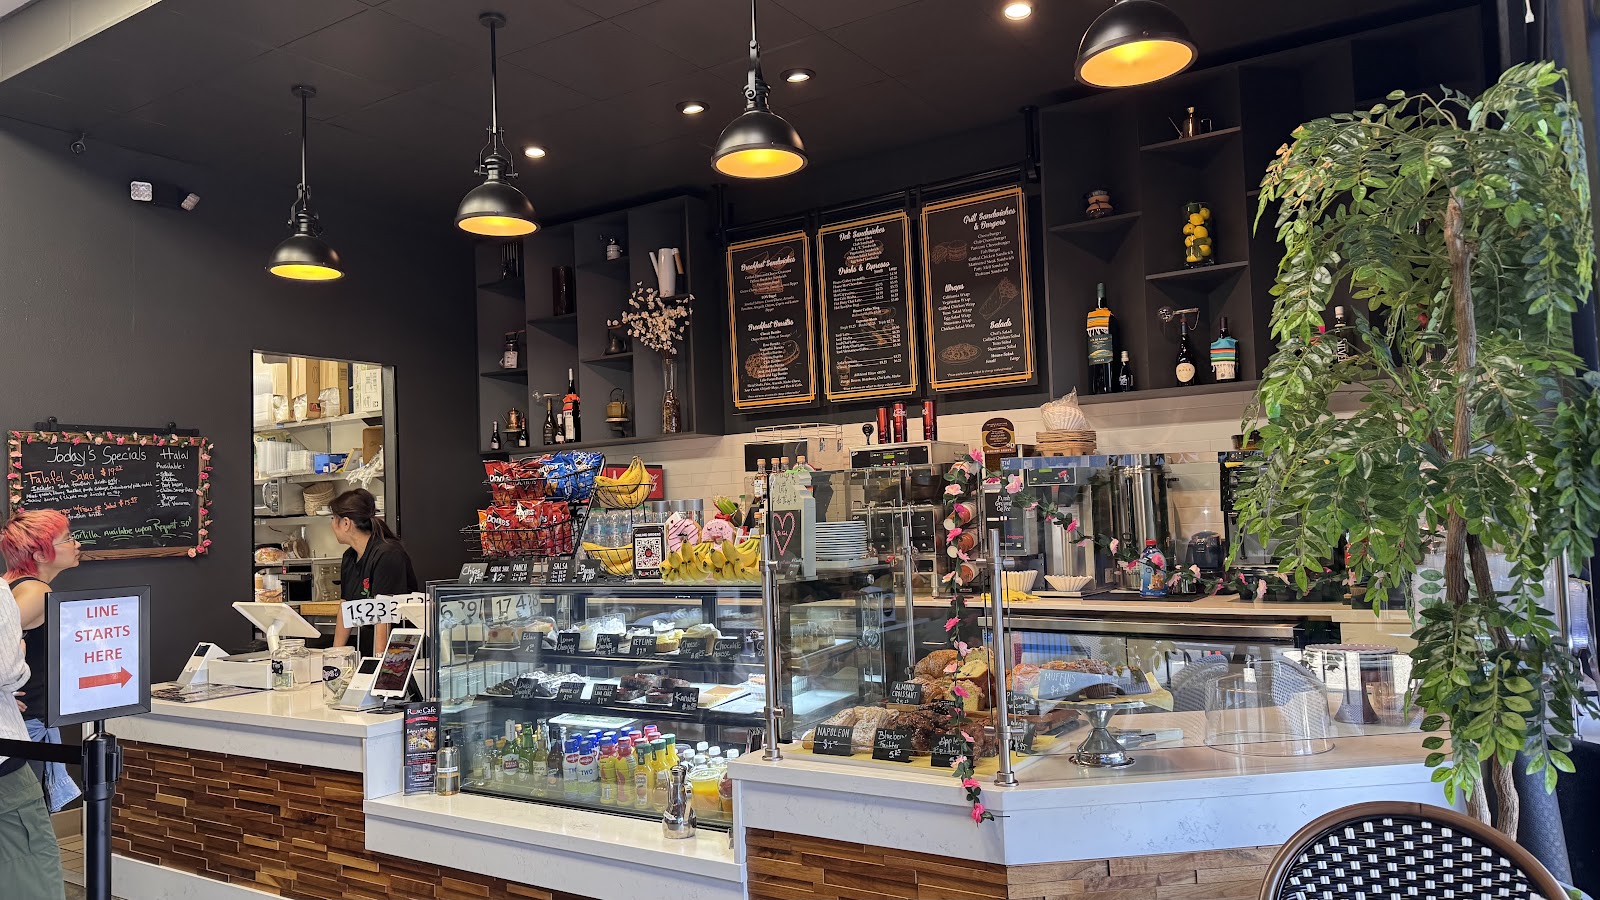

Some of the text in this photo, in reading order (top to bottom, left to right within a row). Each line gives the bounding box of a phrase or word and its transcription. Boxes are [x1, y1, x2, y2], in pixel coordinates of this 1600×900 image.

[978, 206, 1016, 220] Sandwiches
[981, 219, 1006, 229] Burgers
[853, 226, 885, 238] Sandwiches
[741, 260, 766, 271] Breakfast
[748, 321, 773, 331] Breakfast
[990, 318, 1012, 329] Salads
[47, 445, 188, 467] Today's Specials Halal
[25, 470, 64, 484] Falafel
[70, 468, 95, 482] Salad
[86, 604, 118, 619] LINE
[75, 625, 130, 643] STARTS
[85, 648, 122, 663] HERE
[1044, 672, 1076, 683] MUFFINS
[892, 691, 918, 699] CROISSANT
[817, 727, 850, 738] NAPOLEON
